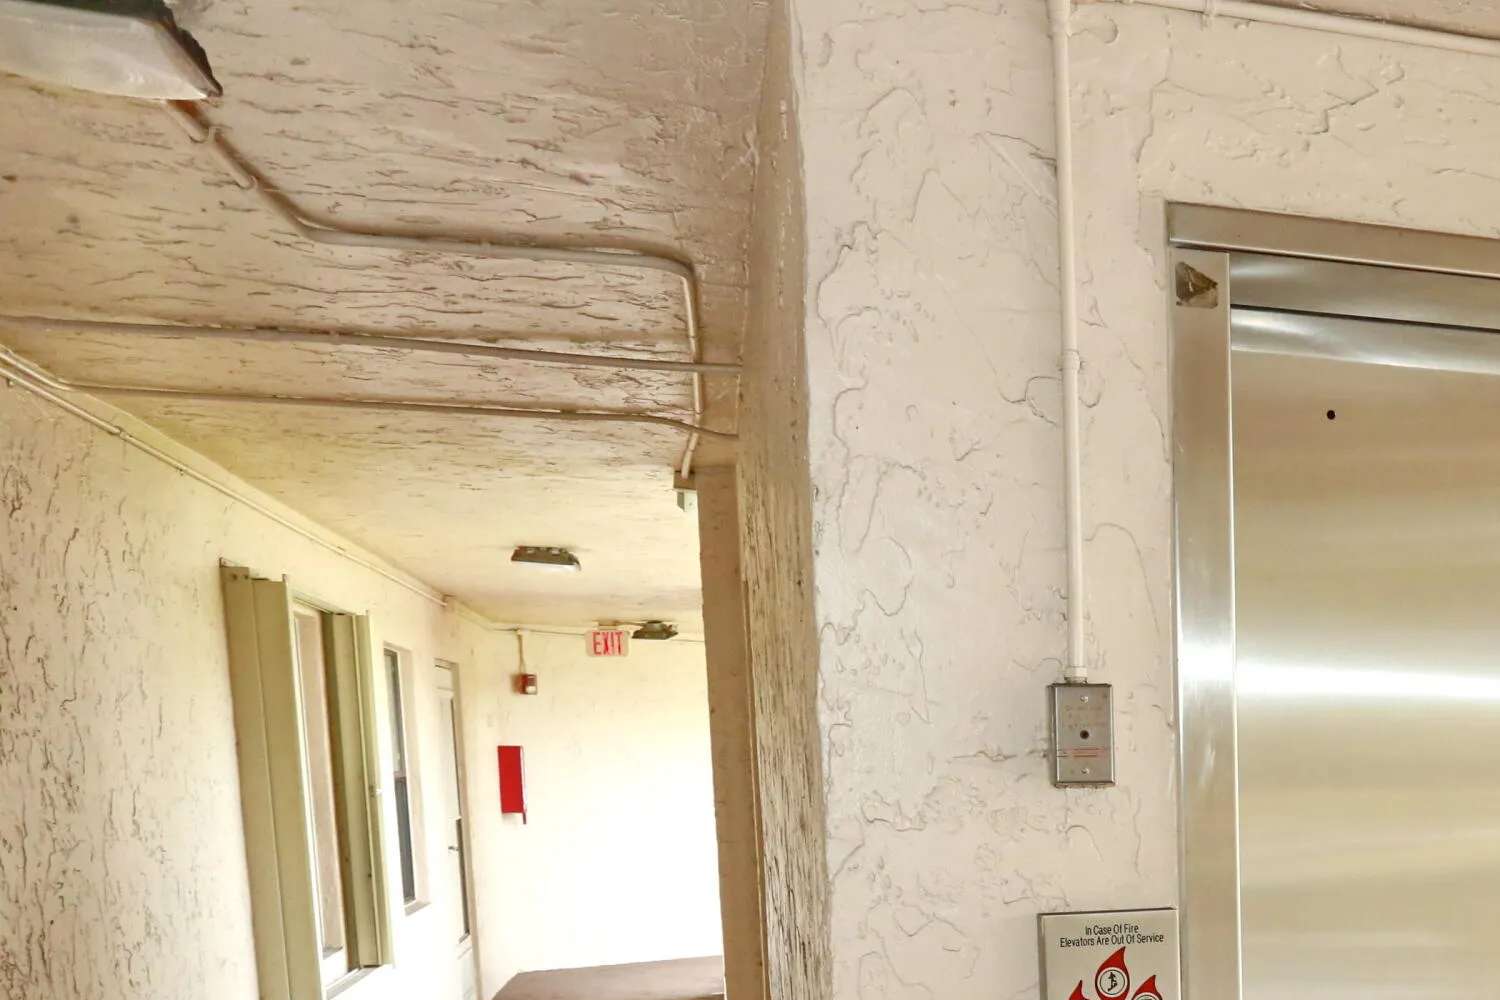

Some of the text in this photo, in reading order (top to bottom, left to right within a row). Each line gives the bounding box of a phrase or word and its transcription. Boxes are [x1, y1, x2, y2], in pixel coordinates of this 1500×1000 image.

[593, 631, 623, 655] EXIT
[1085, 923, 1139, 935] In Case Of Fire
[1060, 933, 1164, 947] Elevators Are Out Of Service
